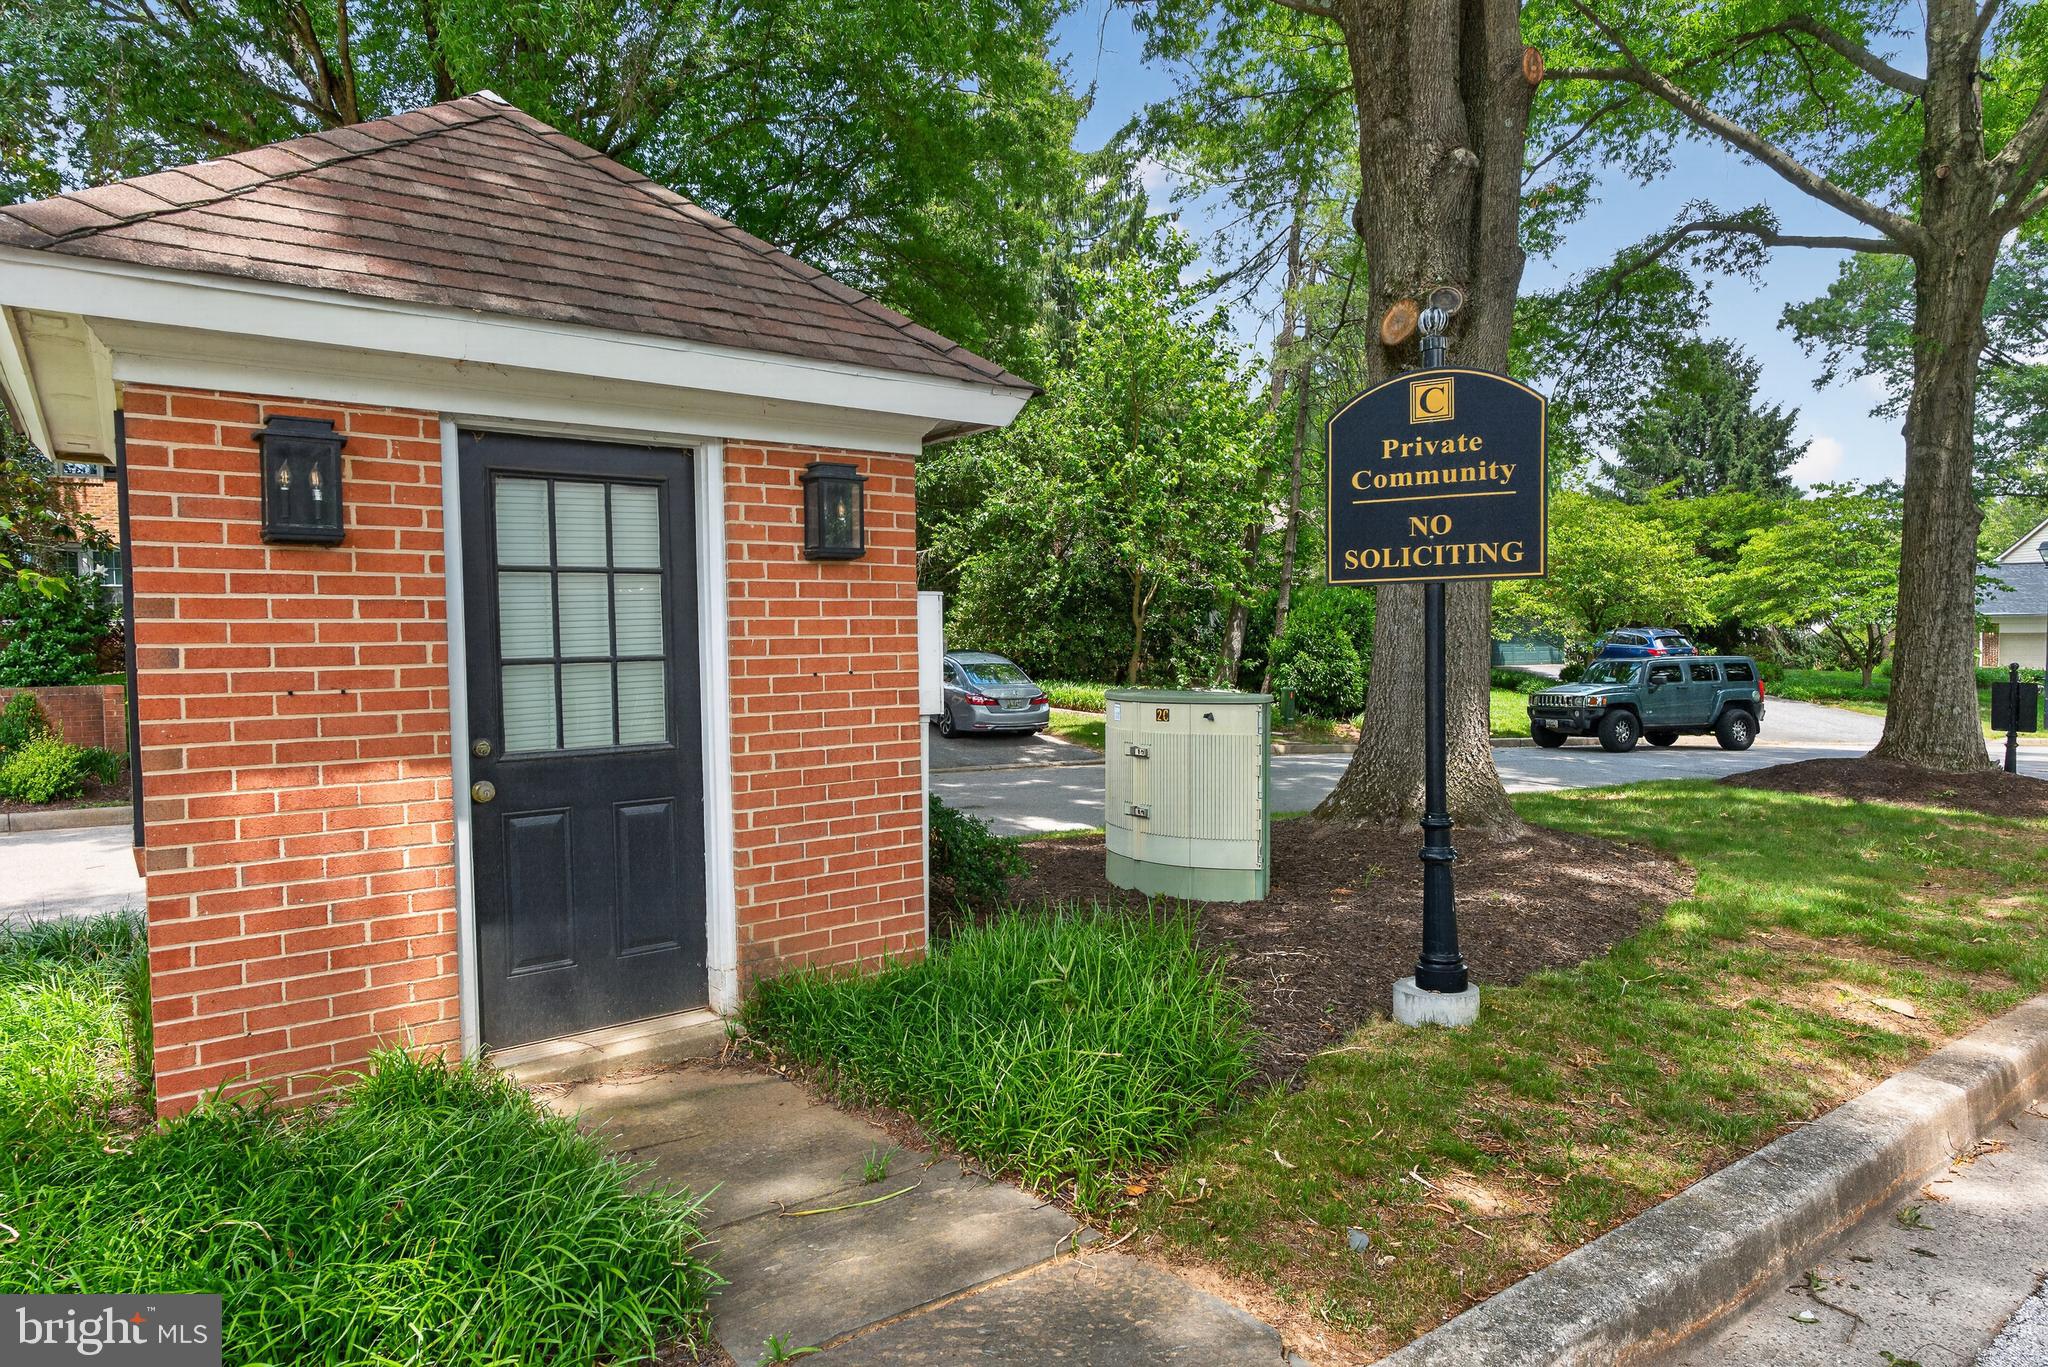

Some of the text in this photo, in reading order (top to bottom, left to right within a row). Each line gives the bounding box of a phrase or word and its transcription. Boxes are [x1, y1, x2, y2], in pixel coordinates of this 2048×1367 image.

[1419, 387, 1445, 414] C
[1381, 433, 1483, 459] Private
[1351, 460, 1517, 490] Community
[1408, 514, 1453, 537] NO
[1344, 541, 1524, 570] SOLICITING
